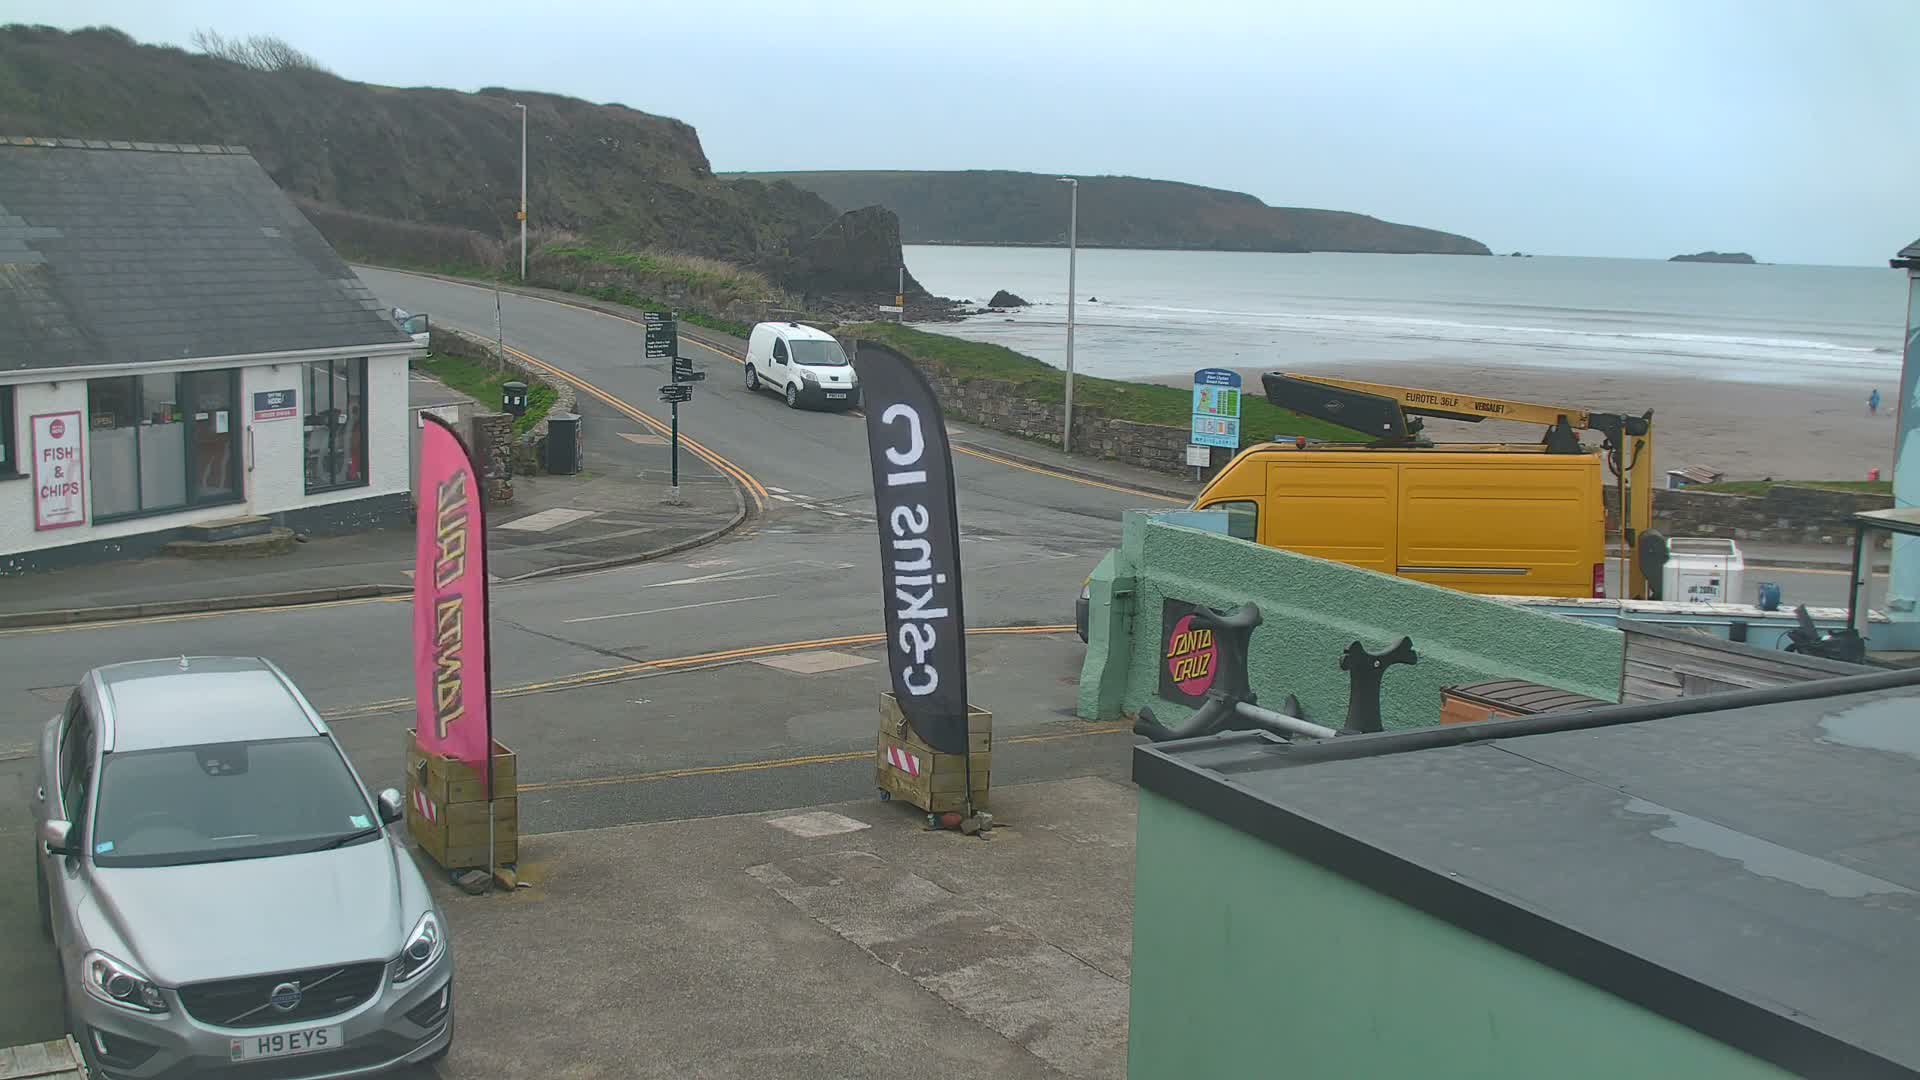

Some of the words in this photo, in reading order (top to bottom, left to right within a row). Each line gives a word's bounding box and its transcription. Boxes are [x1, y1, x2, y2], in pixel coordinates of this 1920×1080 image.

[1406, 392, 1438, 405] EUROTEL
[44, 447, 73, 462] FISH
[54, 465, 64, 478] &
[41, 482, 79, 498] CHIPS
[1167, 629, 1213, 659] SANTA
[1173, 652, 1213, 682] CRUZ
[258, 1035, 284, 1055] H9
[289, 1029, 328, 1050] EYS
